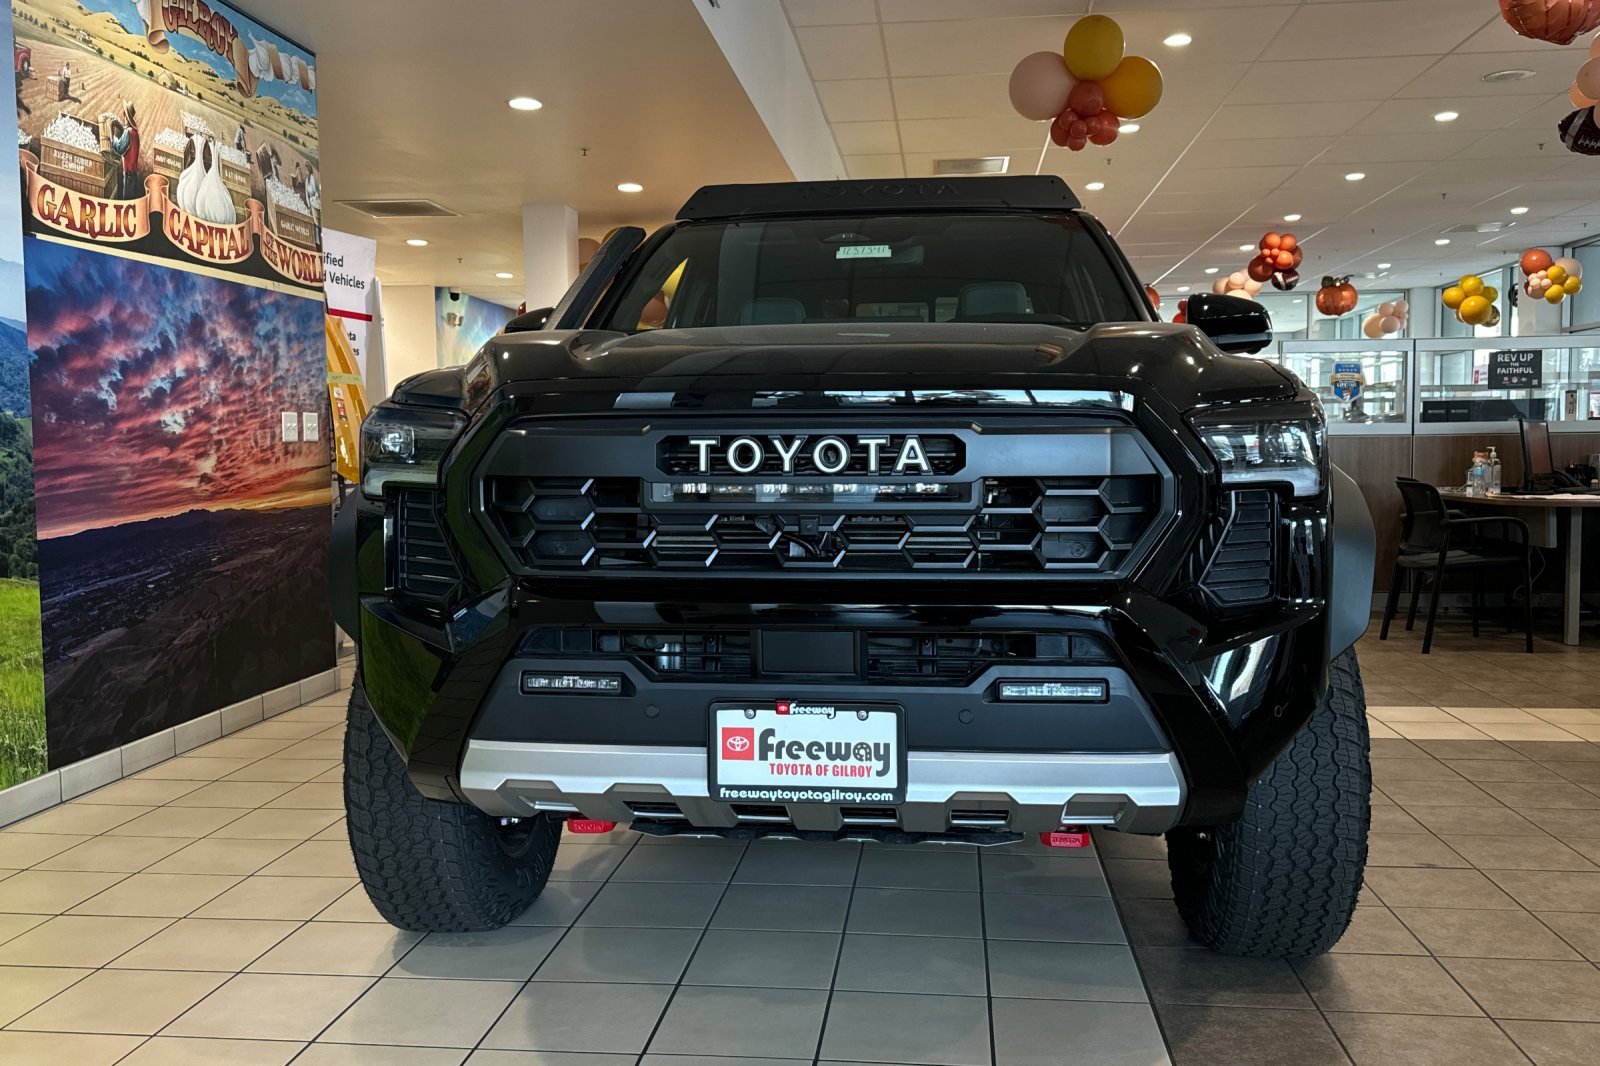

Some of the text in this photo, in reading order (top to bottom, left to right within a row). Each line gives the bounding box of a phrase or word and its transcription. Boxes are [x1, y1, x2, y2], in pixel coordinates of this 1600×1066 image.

[161, 0, 238, 69] GILROY
[36, 184, 250, 260] GARLIC CAPITAL
[329, 270, 365, 290] Vehicles
[1497, 353, 1534, 362] REV UP
[688, 435, 933, 476] TOYOTA
[789, 703, 834, 719] freeway
[758, 728, 891, 777] freeway
[769, 763, 872, 778] TOYOTA OF GILROY
[719, 787, 894, 803] freewaytoyotagilroy.com
